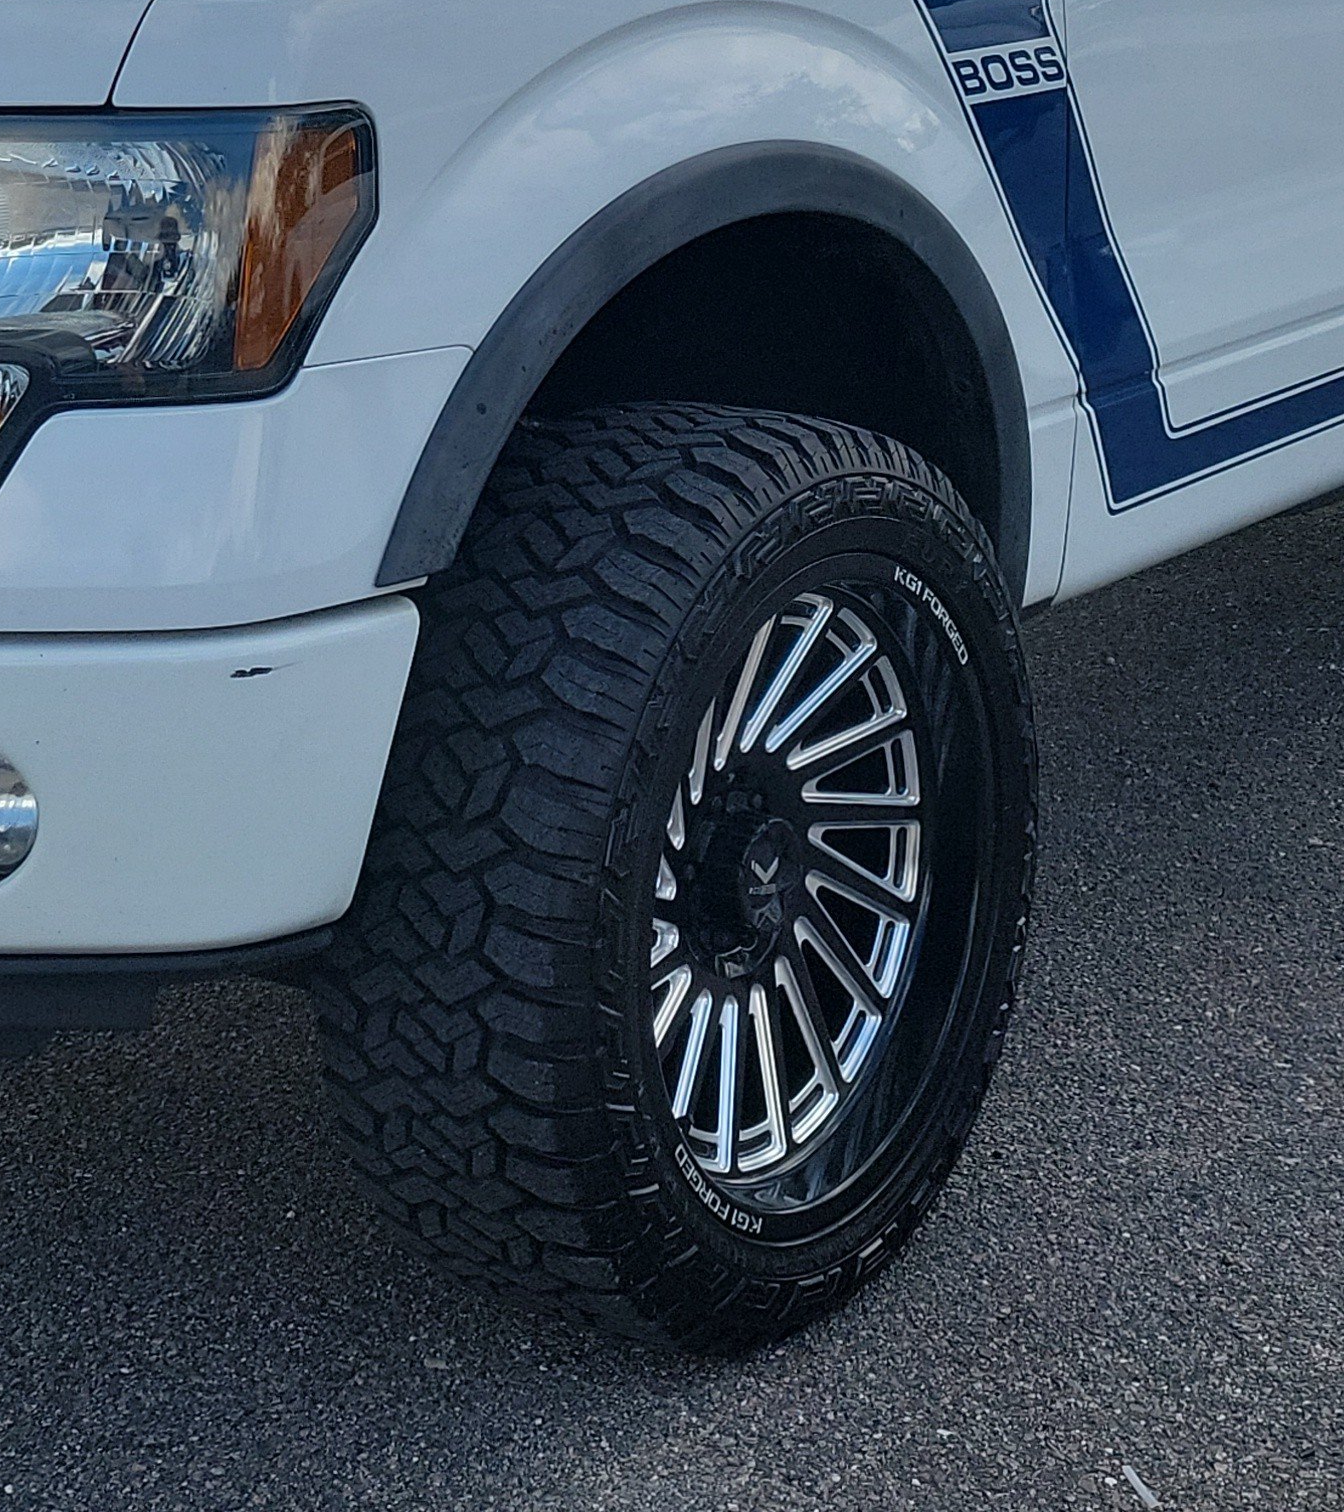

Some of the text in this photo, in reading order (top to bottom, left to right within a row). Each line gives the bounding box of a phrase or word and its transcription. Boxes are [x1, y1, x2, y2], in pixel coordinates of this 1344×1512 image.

[951, 46, 1065, 97] BOSS
[894, 565, 969, 666] KG1 FORGED
[675, 1143, 763, 1234] KG1 FORGED
